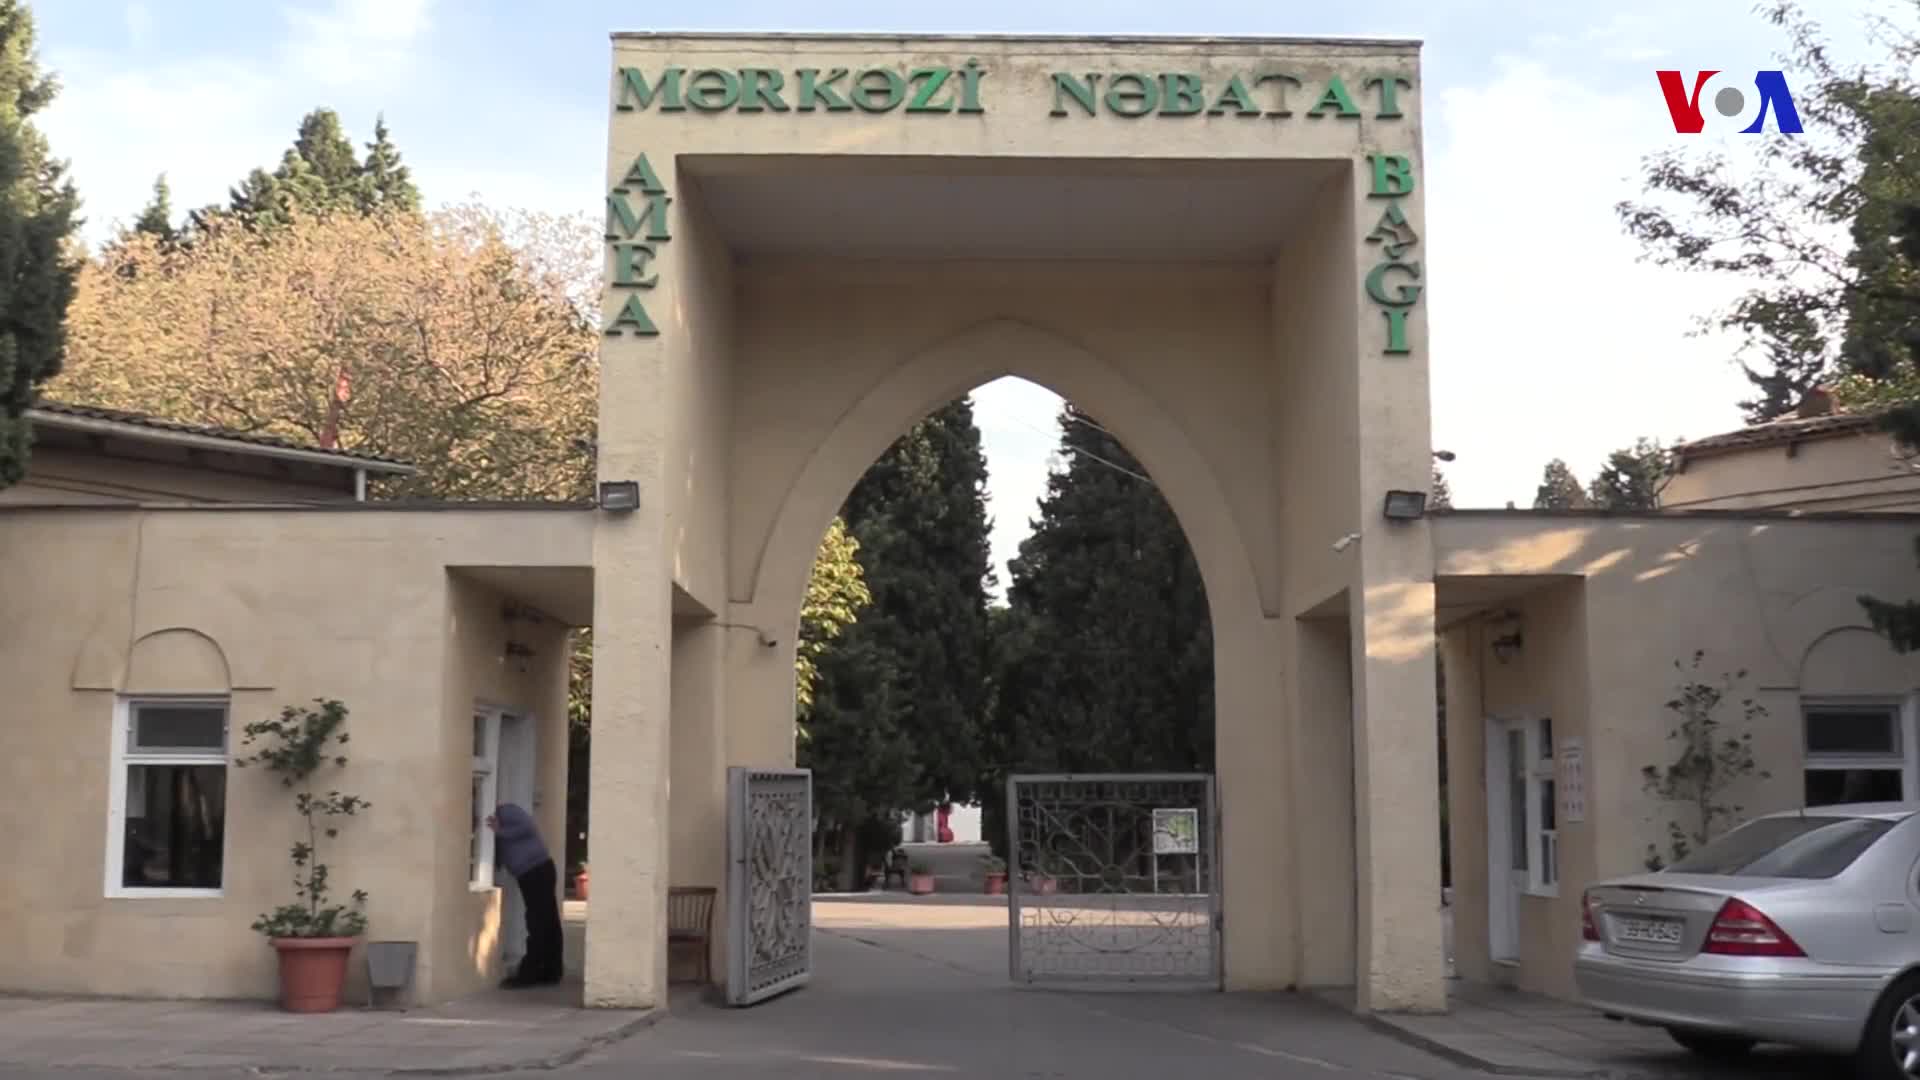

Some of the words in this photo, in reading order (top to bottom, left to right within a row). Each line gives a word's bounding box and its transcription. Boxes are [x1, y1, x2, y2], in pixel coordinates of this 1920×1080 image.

[615, 57, 987, 114] MƏRKƏZİ
[1049, 72, 1412, 120] NƏBATAT
[604, 152, 673, 336] AMEA
[1365, 154, 1422, 355] BAĞI
